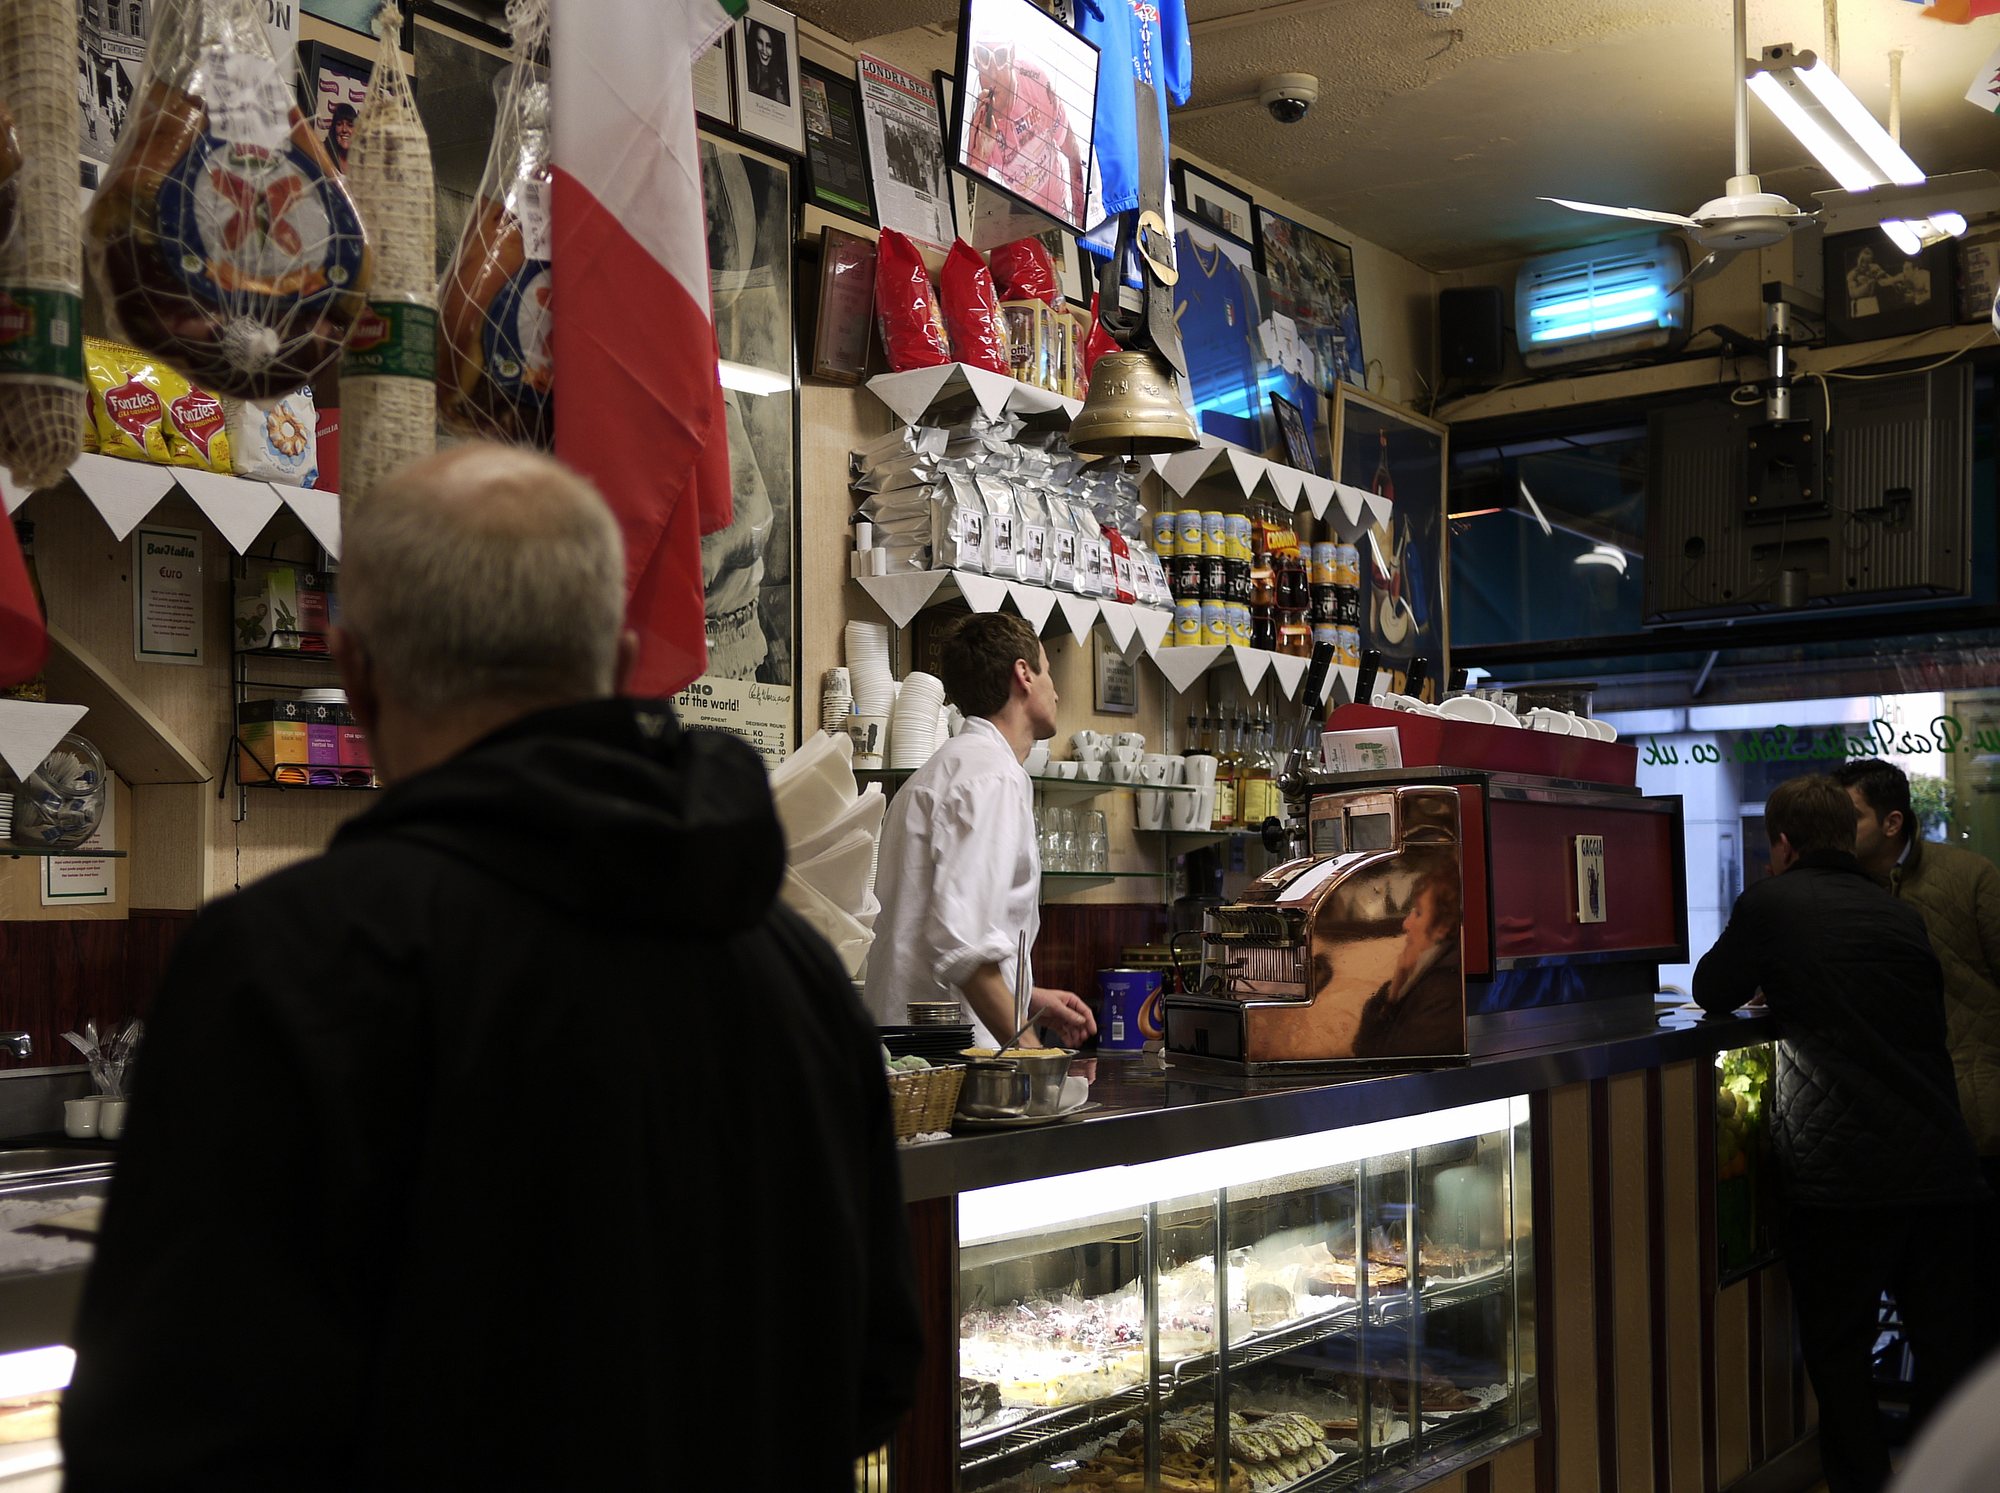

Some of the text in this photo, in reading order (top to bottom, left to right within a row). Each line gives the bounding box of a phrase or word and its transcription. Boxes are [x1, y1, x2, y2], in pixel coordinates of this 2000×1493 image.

[862, 60, 906, 87] LONDRA
[908, 79, 935, 101] SERA
[1011, 344, 1026, 355] otti
[109, 392, 156, 412] Fonzies
[175, 402, 216, 421] Fonzies
[679, 695, 690, 706] of
[692, 695, 708, 708] the
[710, 698, 740, 712] world!
[700, 715, 727, 723] OPPONENT
[745, 720, 768, 728] DECISION
[1581, 838, 1603, 857] GAGGIA
